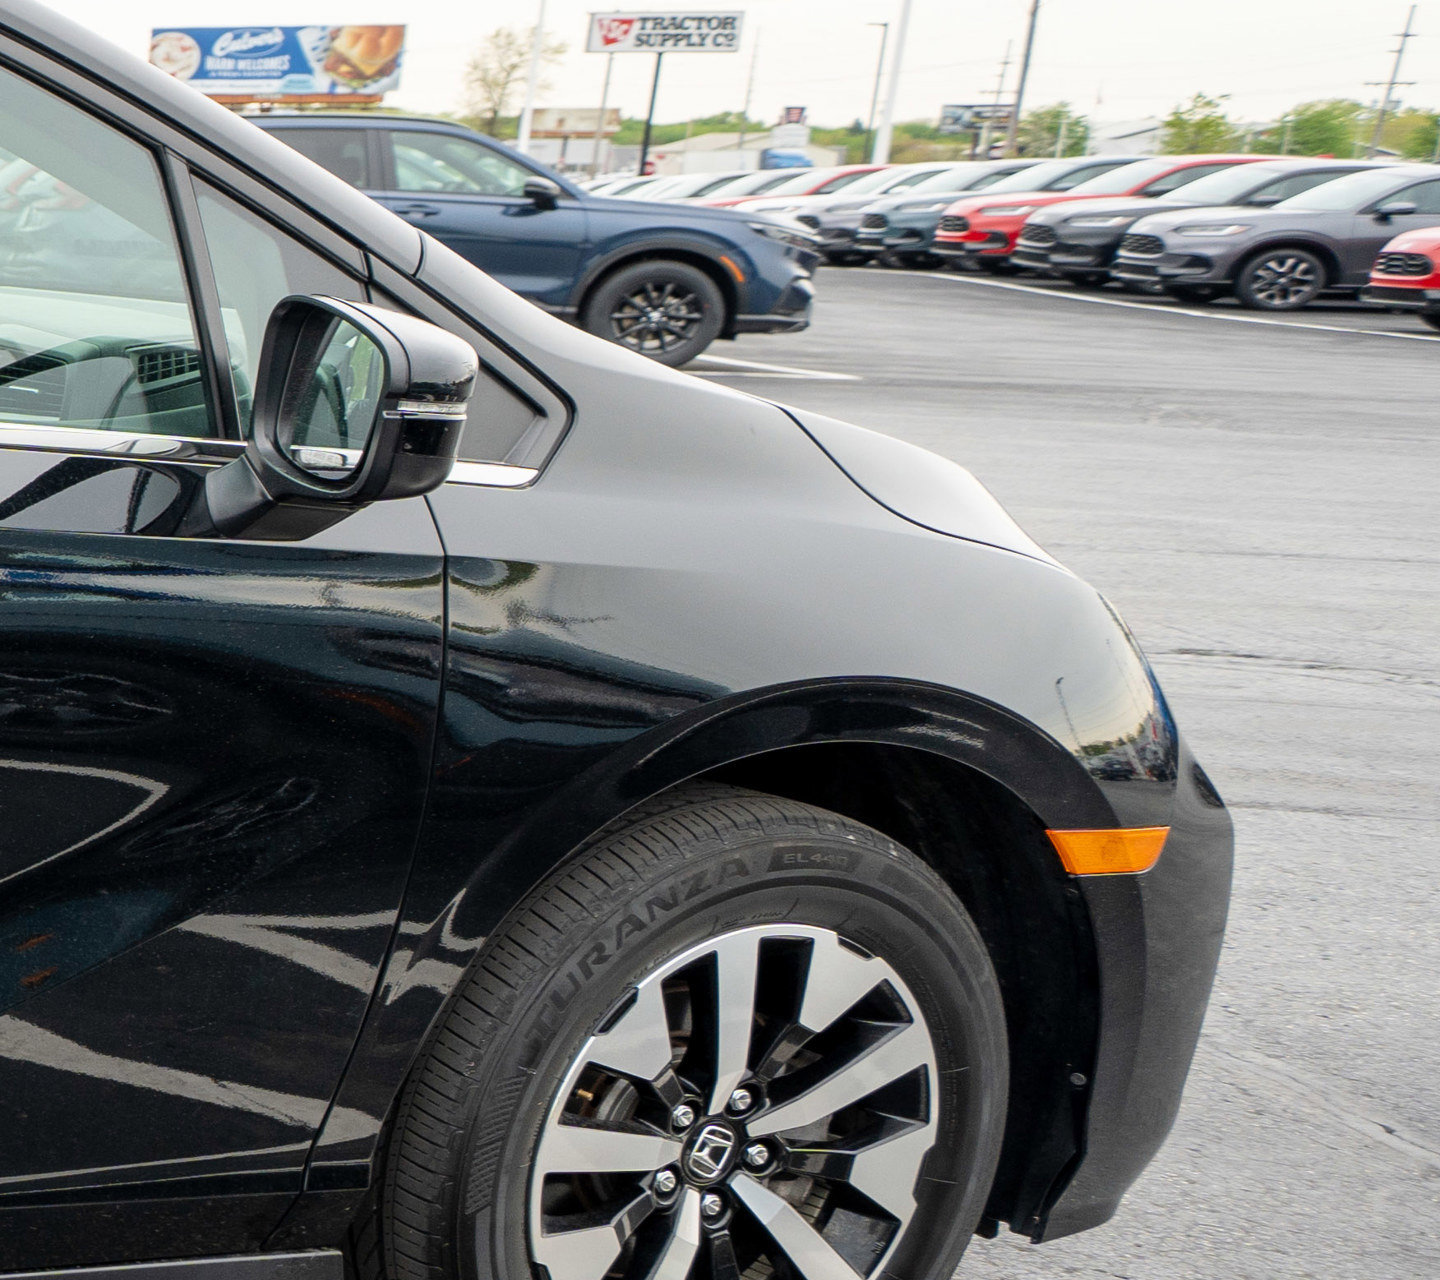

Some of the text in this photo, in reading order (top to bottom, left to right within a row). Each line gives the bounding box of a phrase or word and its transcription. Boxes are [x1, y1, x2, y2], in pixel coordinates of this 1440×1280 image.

[637, 16, 737, 31] TRACTOR
[633, 33, 710, 47] SUPPLY
[524, 856, 750, 1046] TURANZA
